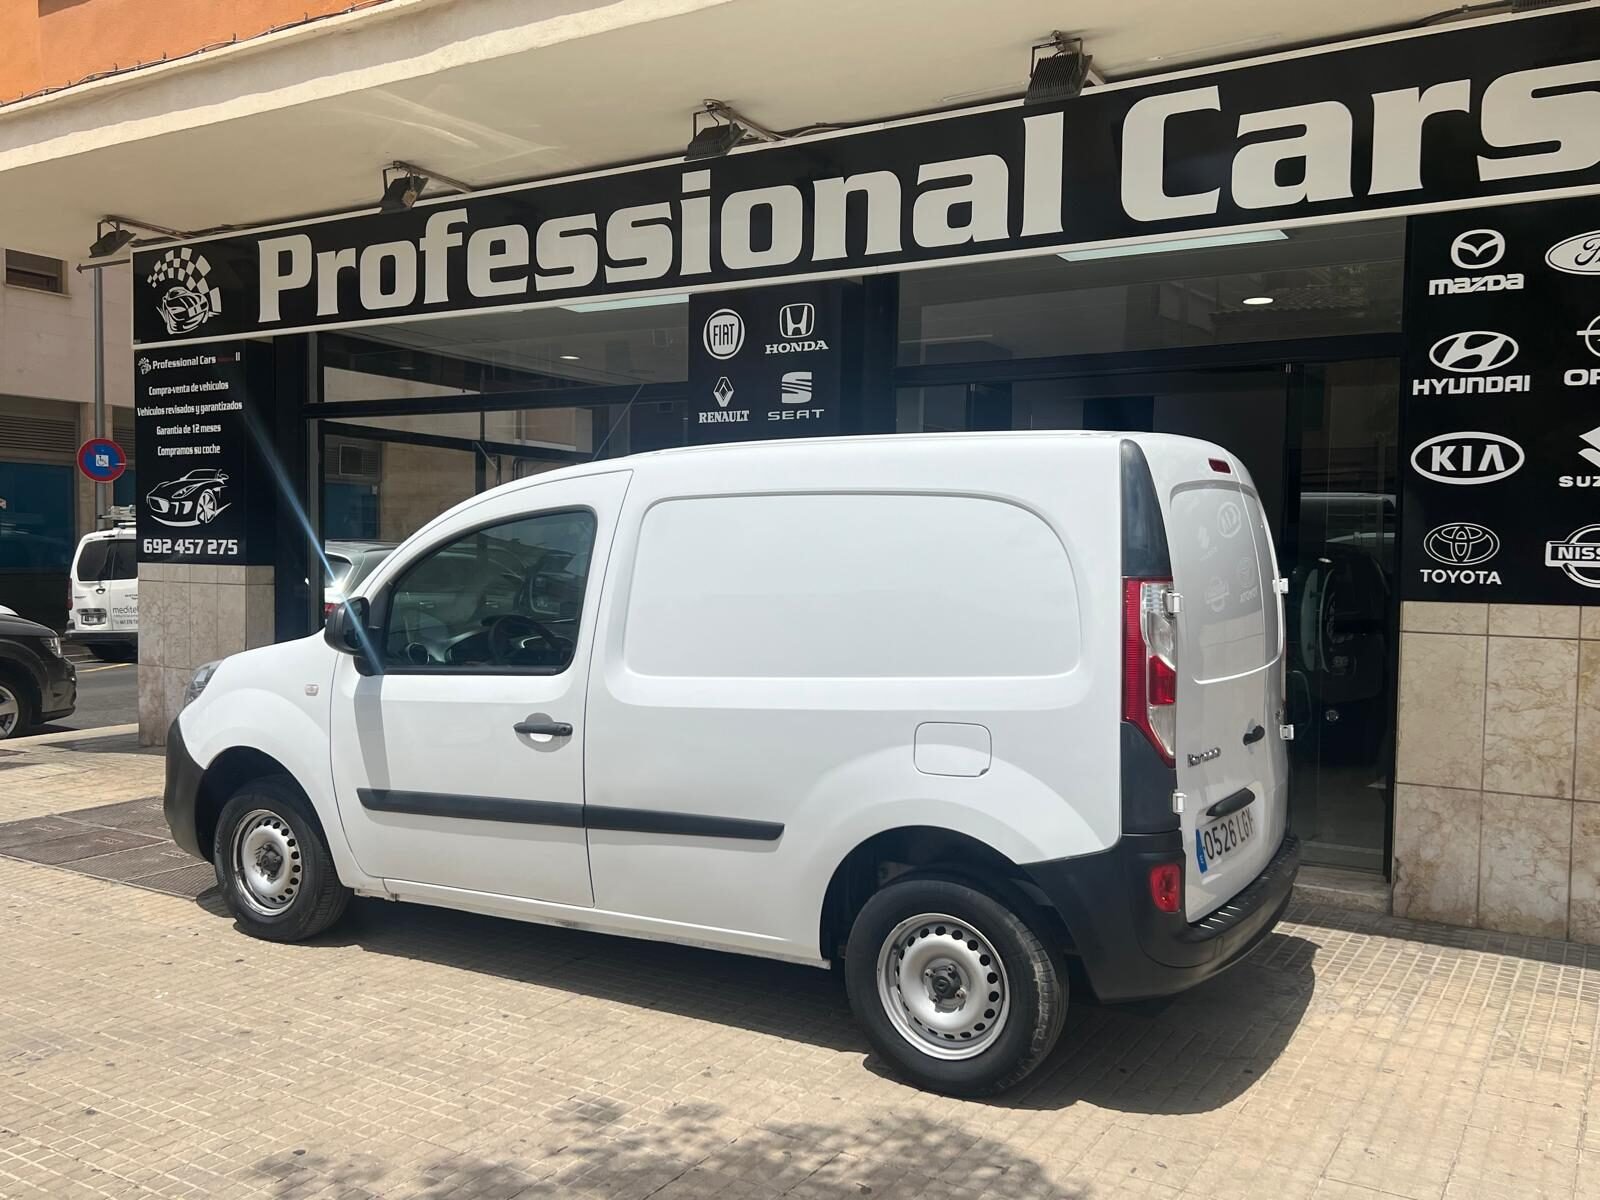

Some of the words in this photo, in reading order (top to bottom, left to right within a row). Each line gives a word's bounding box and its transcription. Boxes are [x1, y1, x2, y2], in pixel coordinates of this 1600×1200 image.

[258, 110, 1064, 324] Professional
[1121, 59, 1600, 223] Cars
[713, 324, 735, 346] FIAT
[765, 340, 829, 354] HONDA
[153, 357, 199, 369] Professional
[200, 355, 217, 365] Cars
[149, 385, 190, 397] Compra-venta
[191, 383, 199, 392] de
[1412, 375, 1531, 396] HYUNDAI
[166, 404, 194, 414] revisados
[195, 404, 200, 415] y
[201, 401, 242, 414] garantizados
[767, 409, 825, 421] SEAT
[698, 410, 750, 424] RENAULT
[183, 425, 191, 434] de
[192, 423, 200, 434] 12
[157, 446, 193, 457] Compramos
[194, 446, 202, 455] su
[203, 444, 221, 454] coche
[1431, 444, 1506, 472] KIA
[143, 538, 172, 554] 692
[174, 538, 204, 555] 457
[207, 539, 238, 555] 275
[1420, 569, 1502, 585] TOYOTA
[1203, 819, 1237, 860] 0526
